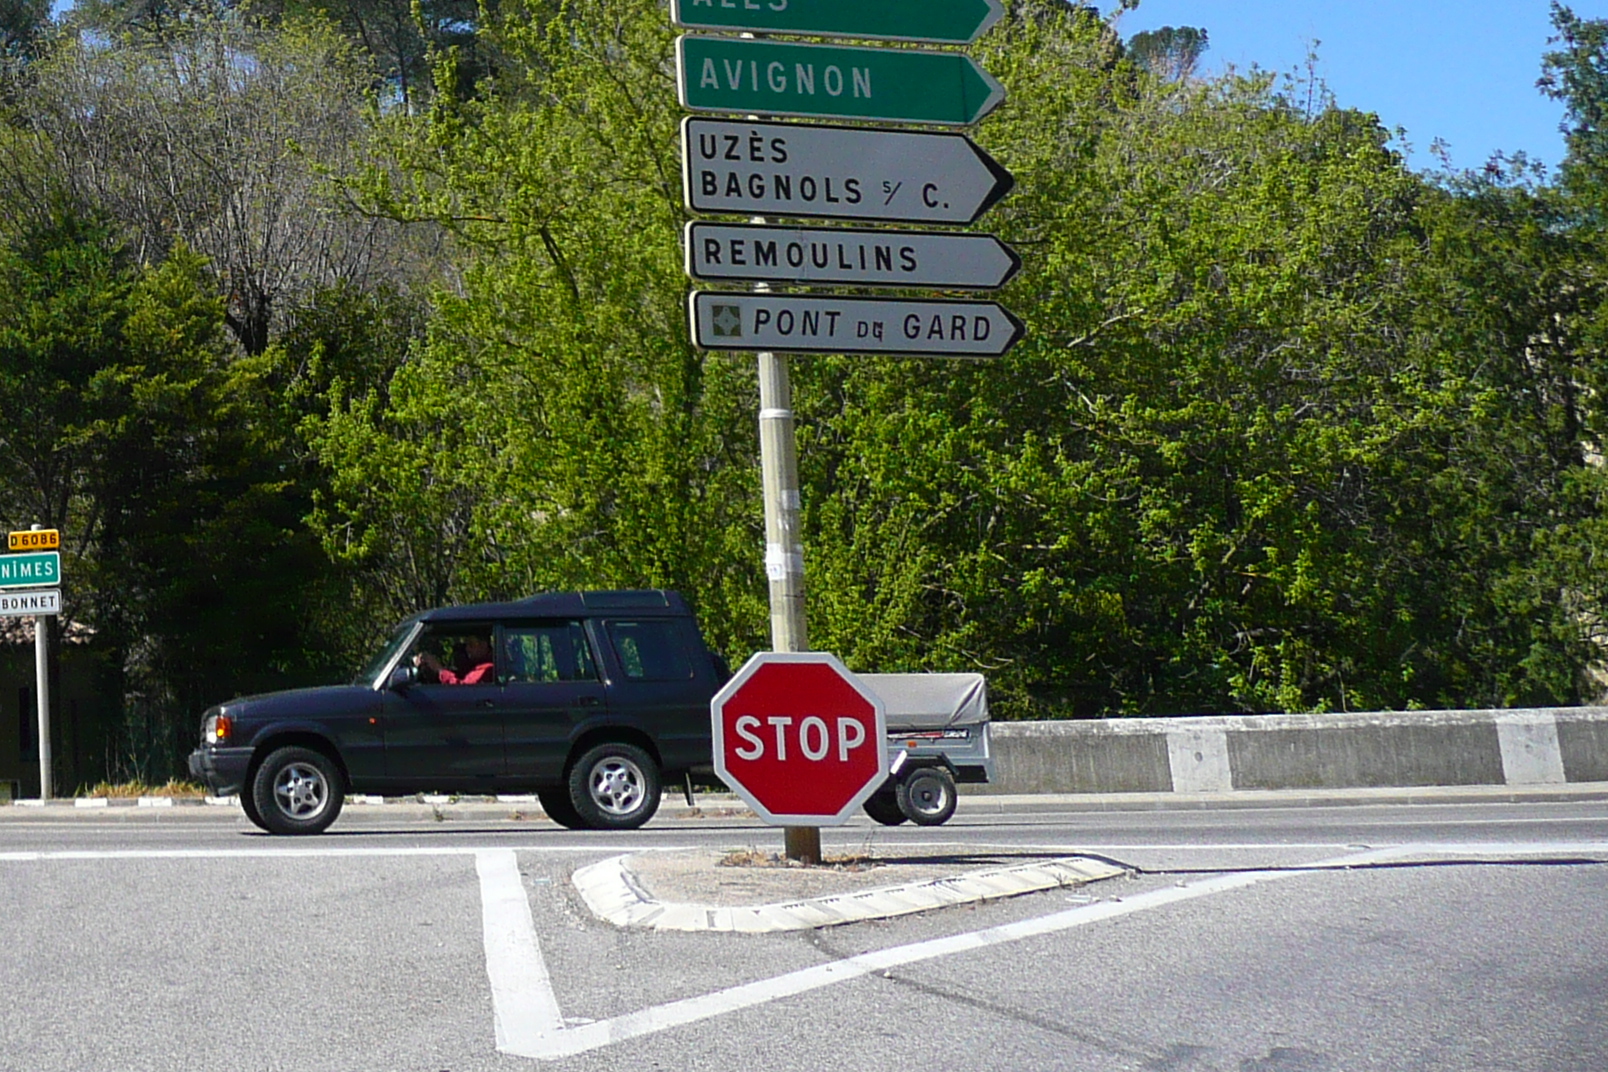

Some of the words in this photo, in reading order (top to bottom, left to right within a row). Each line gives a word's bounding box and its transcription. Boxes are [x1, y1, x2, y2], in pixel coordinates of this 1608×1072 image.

[700, 57, 872, 98] AVIGNON
[699, 130, 788, 164] UZÈS
[702, 170, 862, 204] BAGNOLS
[922, 182, 949, 209] C.
[704, 238, 918, 272] REMOULINS
[754, 308, 841, 336] PONT
[903, 314, 992, 341] GARD
[10, 535, 18, 546] D
[21, 533, 57, 546] 6086
[1, 560, 54, 579] NÎMES
[2, 595, 56, 610] BONNET
[734, 715, 866, 762] STOP
